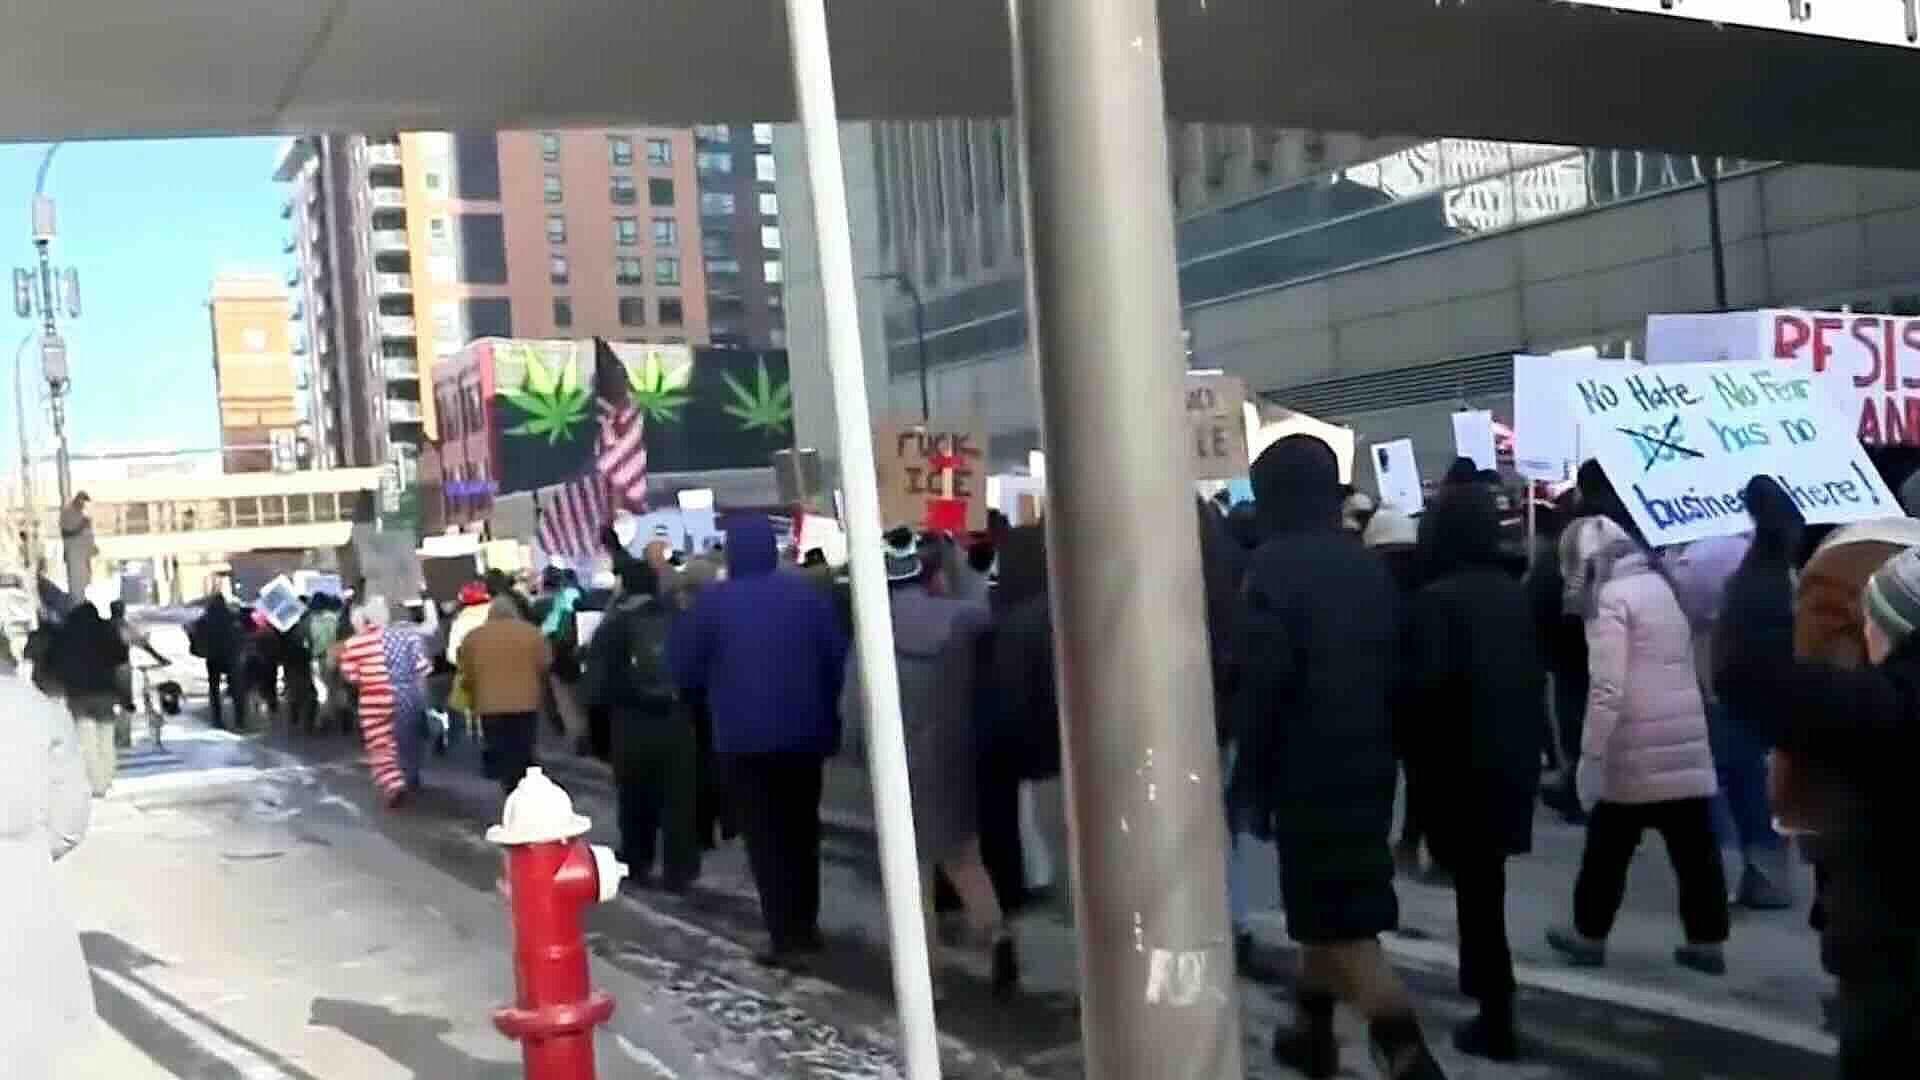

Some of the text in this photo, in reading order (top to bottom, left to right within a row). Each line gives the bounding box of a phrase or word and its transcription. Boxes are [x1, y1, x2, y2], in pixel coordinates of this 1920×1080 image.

[1577, 378, 1620, 414] No
[1711, 371, 1757, 410] No
[1706, 416, 1771, 453] has
[1779, 417, 1818, 445] no
[904, 467, 972, 496] ICE
[1632, 460, 1880, 530] busine here!
